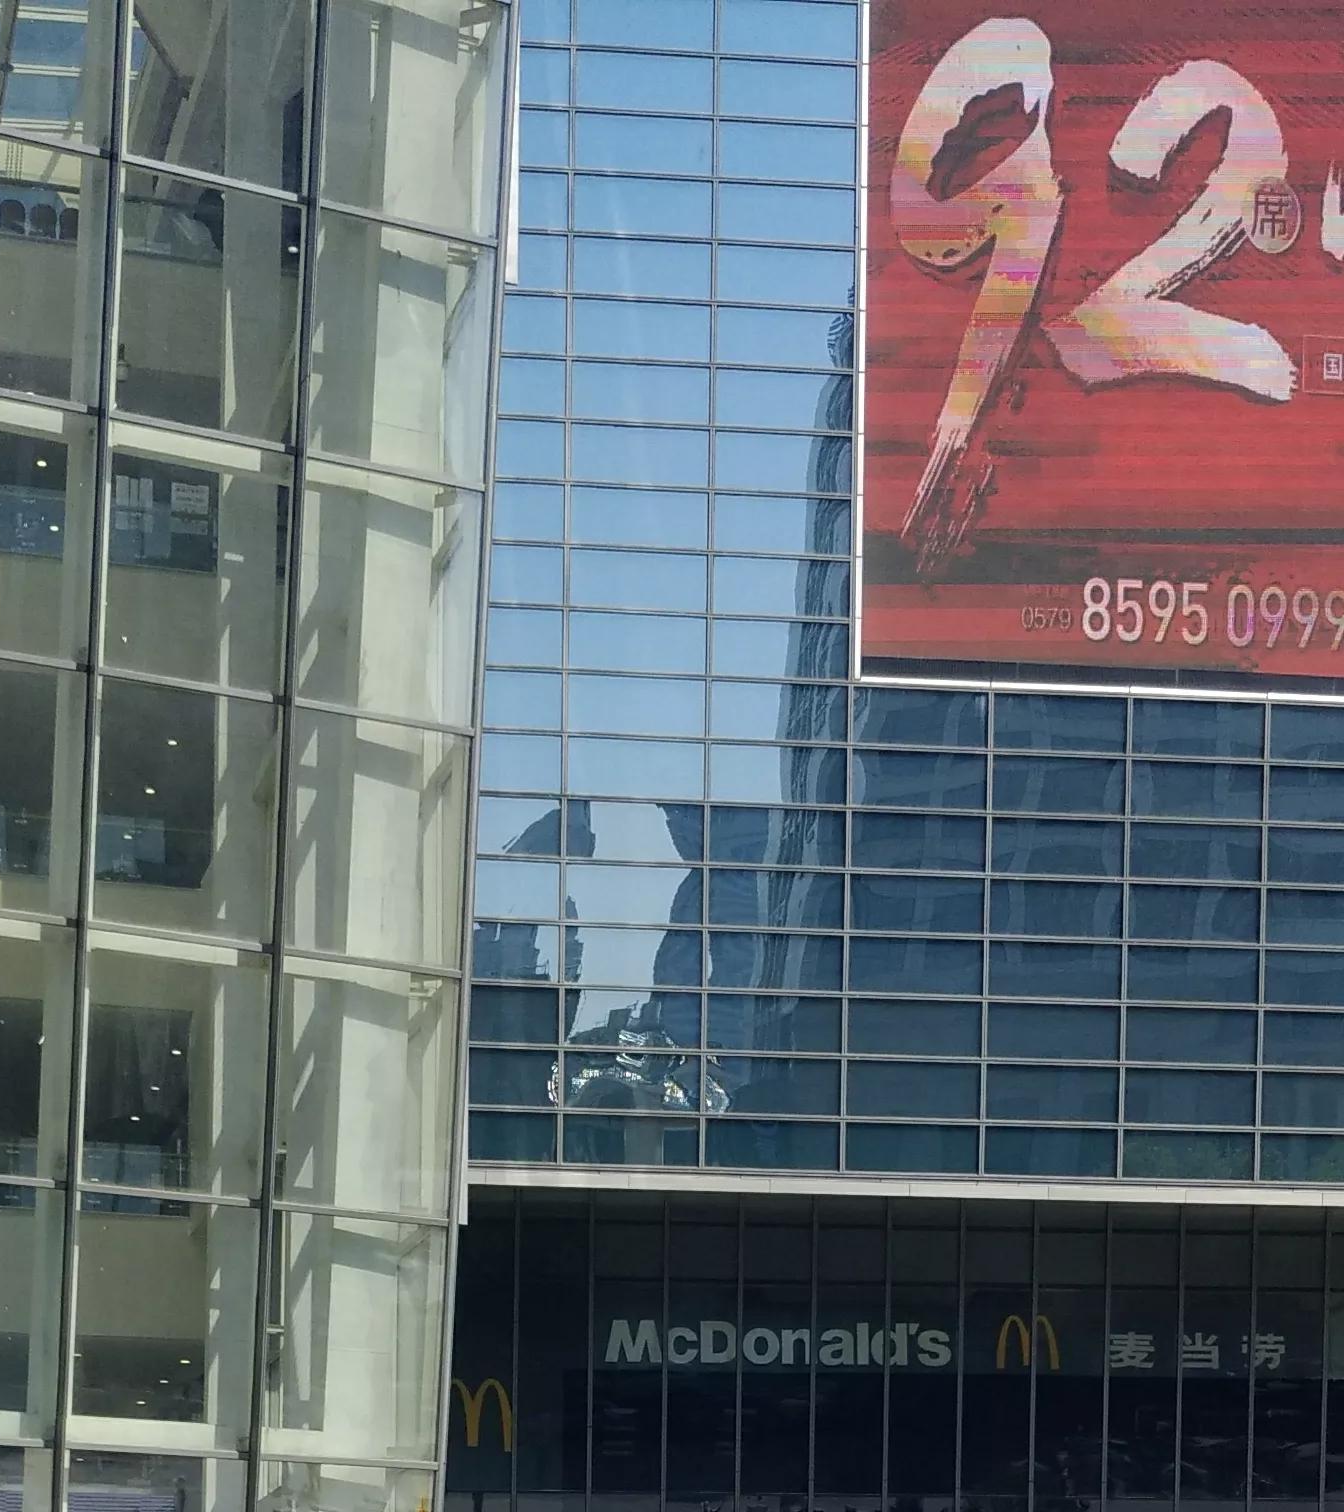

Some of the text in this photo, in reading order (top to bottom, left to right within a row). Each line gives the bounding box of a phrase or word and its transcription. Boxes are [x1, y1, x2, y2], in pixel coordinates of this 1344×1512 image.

[1021, 606, 1073, 631] 0579
[1082, 576, 1209, 646] 8595
[604, 1318, 953, 1367] McDonald's
[1107, 1331, 1288, 1371] 麦当劳
